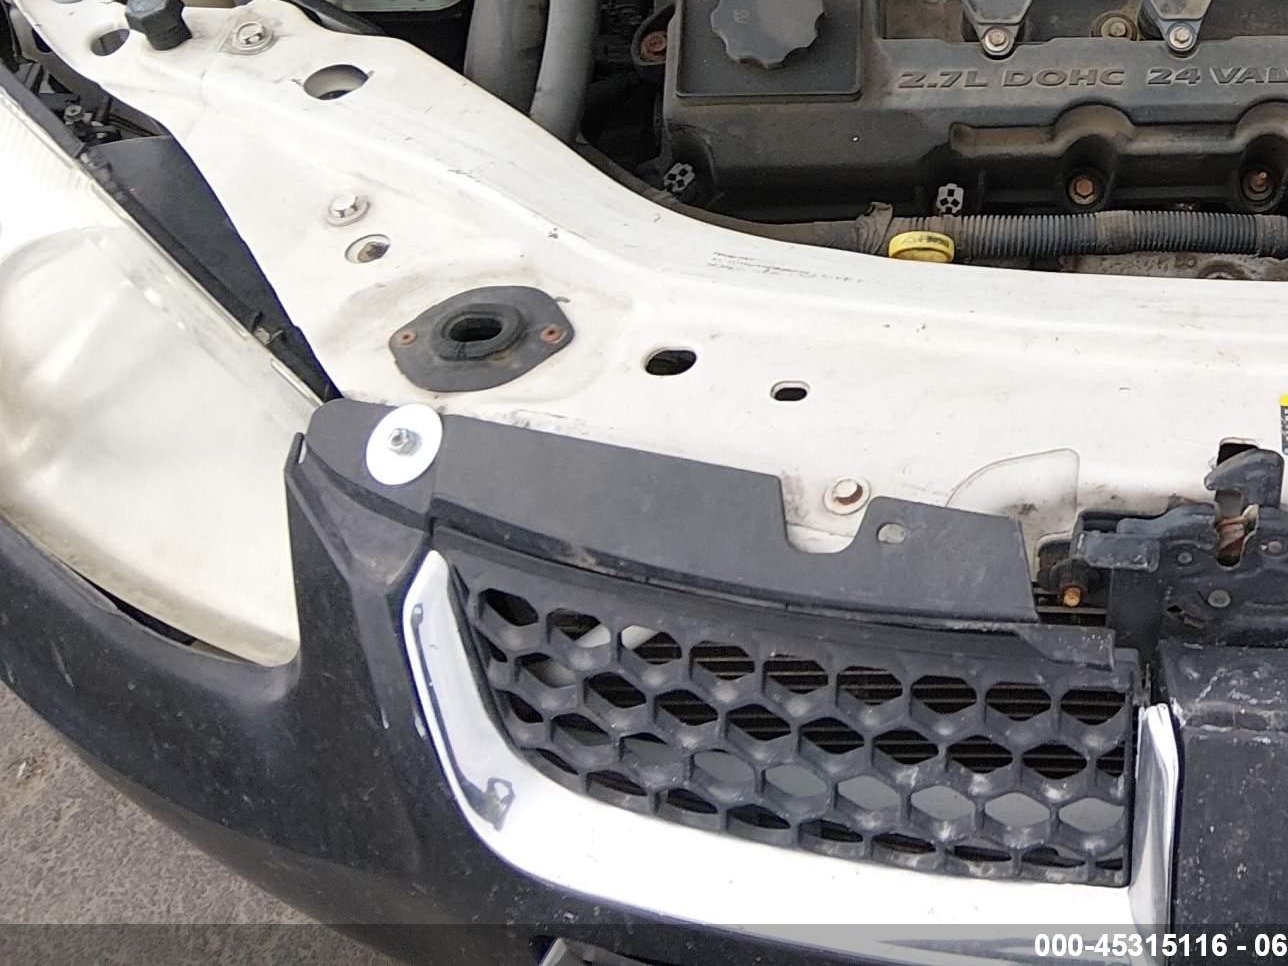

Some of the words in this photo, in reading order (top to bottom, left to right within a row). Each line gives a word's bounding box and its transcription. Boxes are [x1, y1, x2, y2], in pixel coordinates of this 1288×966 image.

[898, 69, 989, 89] 2.7L
[1002, 68, 1126, 87] DOHC
[1147, 67, 1200, 85] 24
